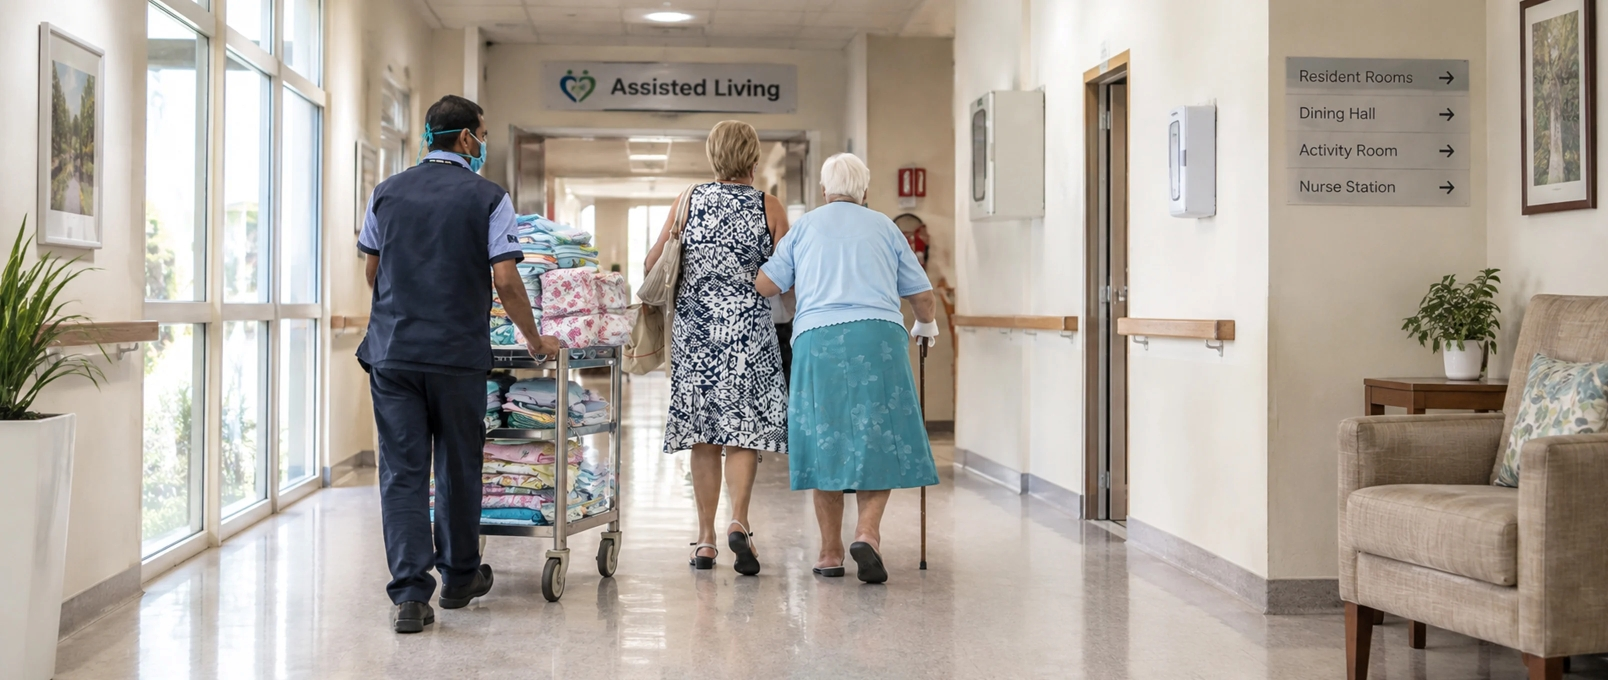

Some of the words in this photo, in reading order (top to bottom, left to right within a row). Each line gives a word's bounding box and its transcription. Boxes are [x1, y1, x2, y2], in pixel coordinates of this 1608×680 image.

[1299, 69, 1362, 83] Resident
[1365, 70, 1414, 84] Rooms
[610, 78, 707, 97] Assisted
[714, 79, 781, 102] Living
[1299, 106, 1345, 123] Dining
[1349, 107, 1376, 120] Hall
[1299, 143, 1353, 160] Activity
[1356, 143, 1398, 157] Room
[1299, 180, 1342, 193] Nurse
[1345, 180, 1396, 193] Station
